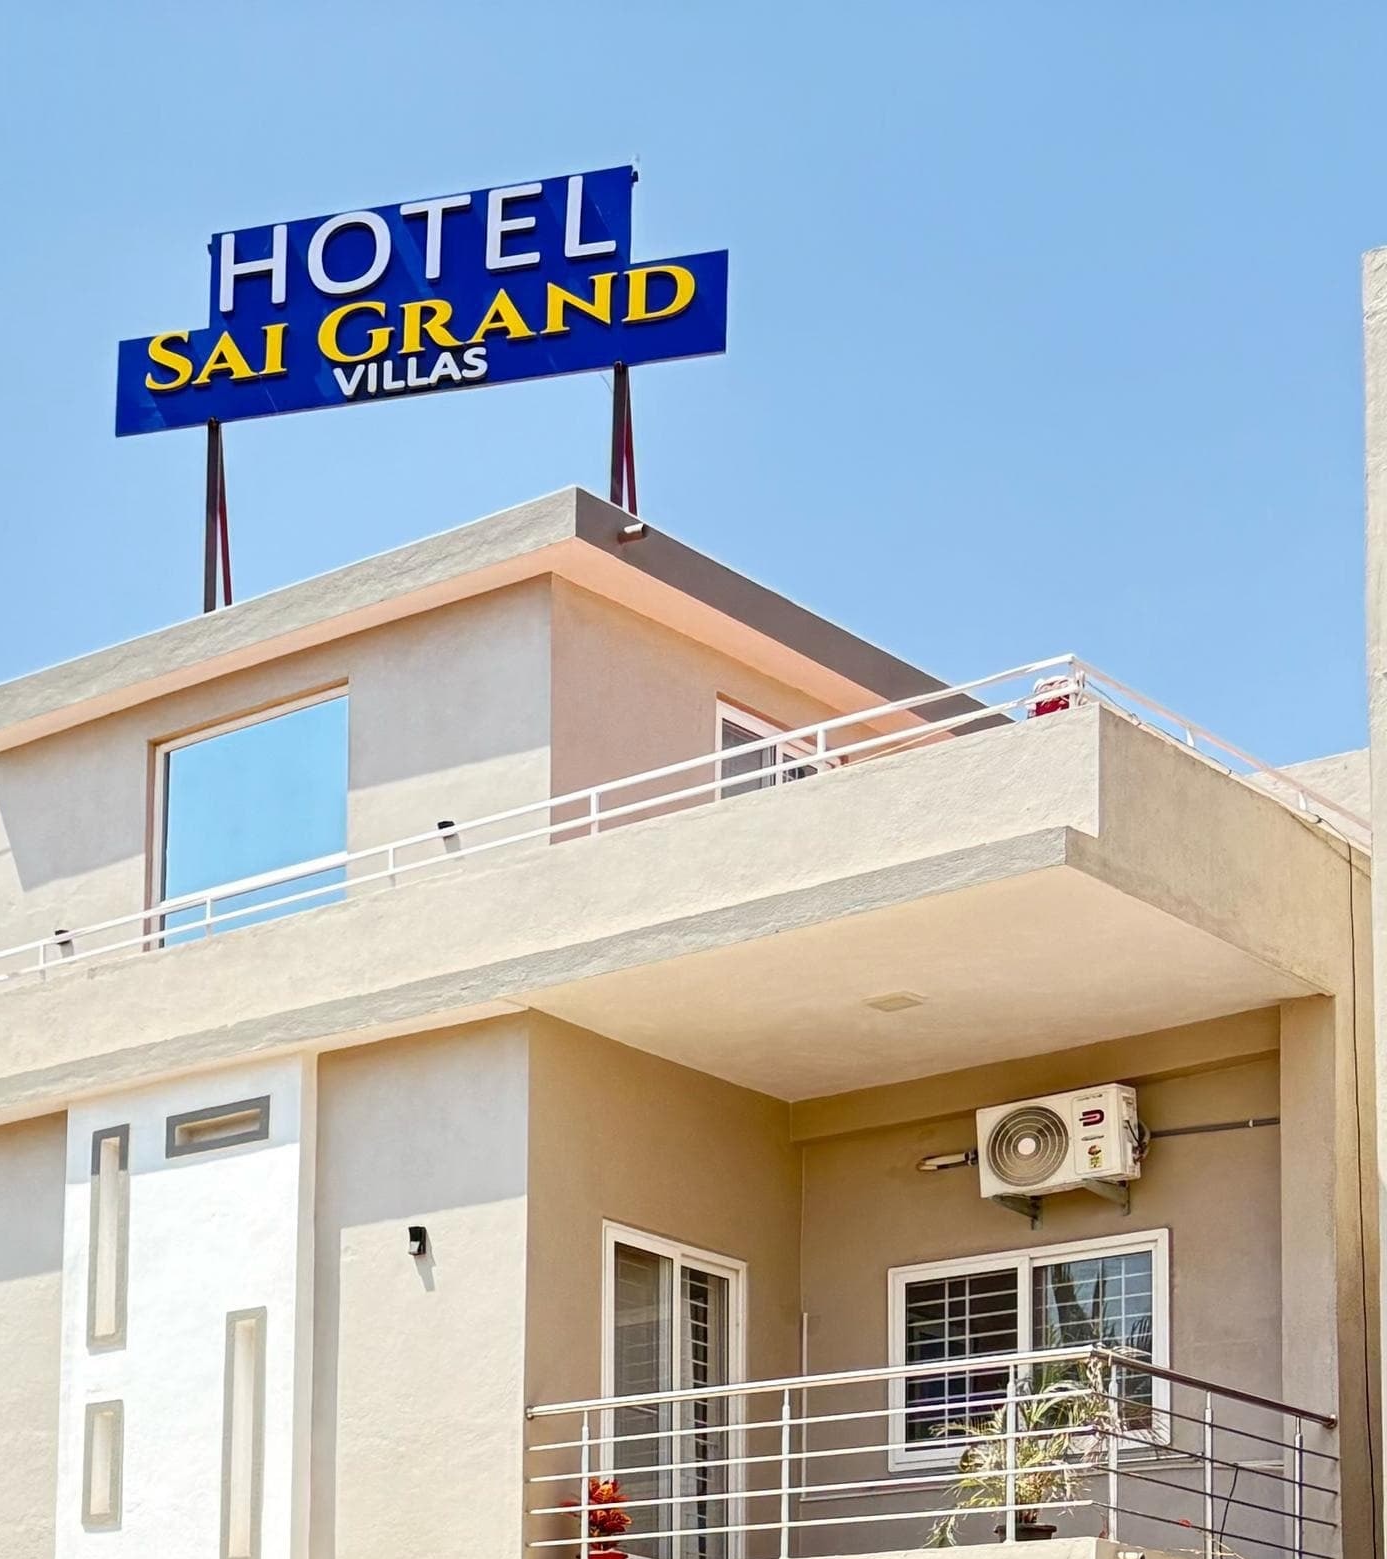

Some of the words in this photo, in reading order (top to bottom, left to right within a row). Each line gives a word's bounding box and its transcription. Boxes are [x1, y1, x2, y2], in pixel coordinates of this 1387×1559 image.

[219, 174, 617, 313] HOTEL
[144, 322, 290, 392] SAI
[317, 264, 697, 364] GRAND
[332, 346, 489, 397] VILLAS
